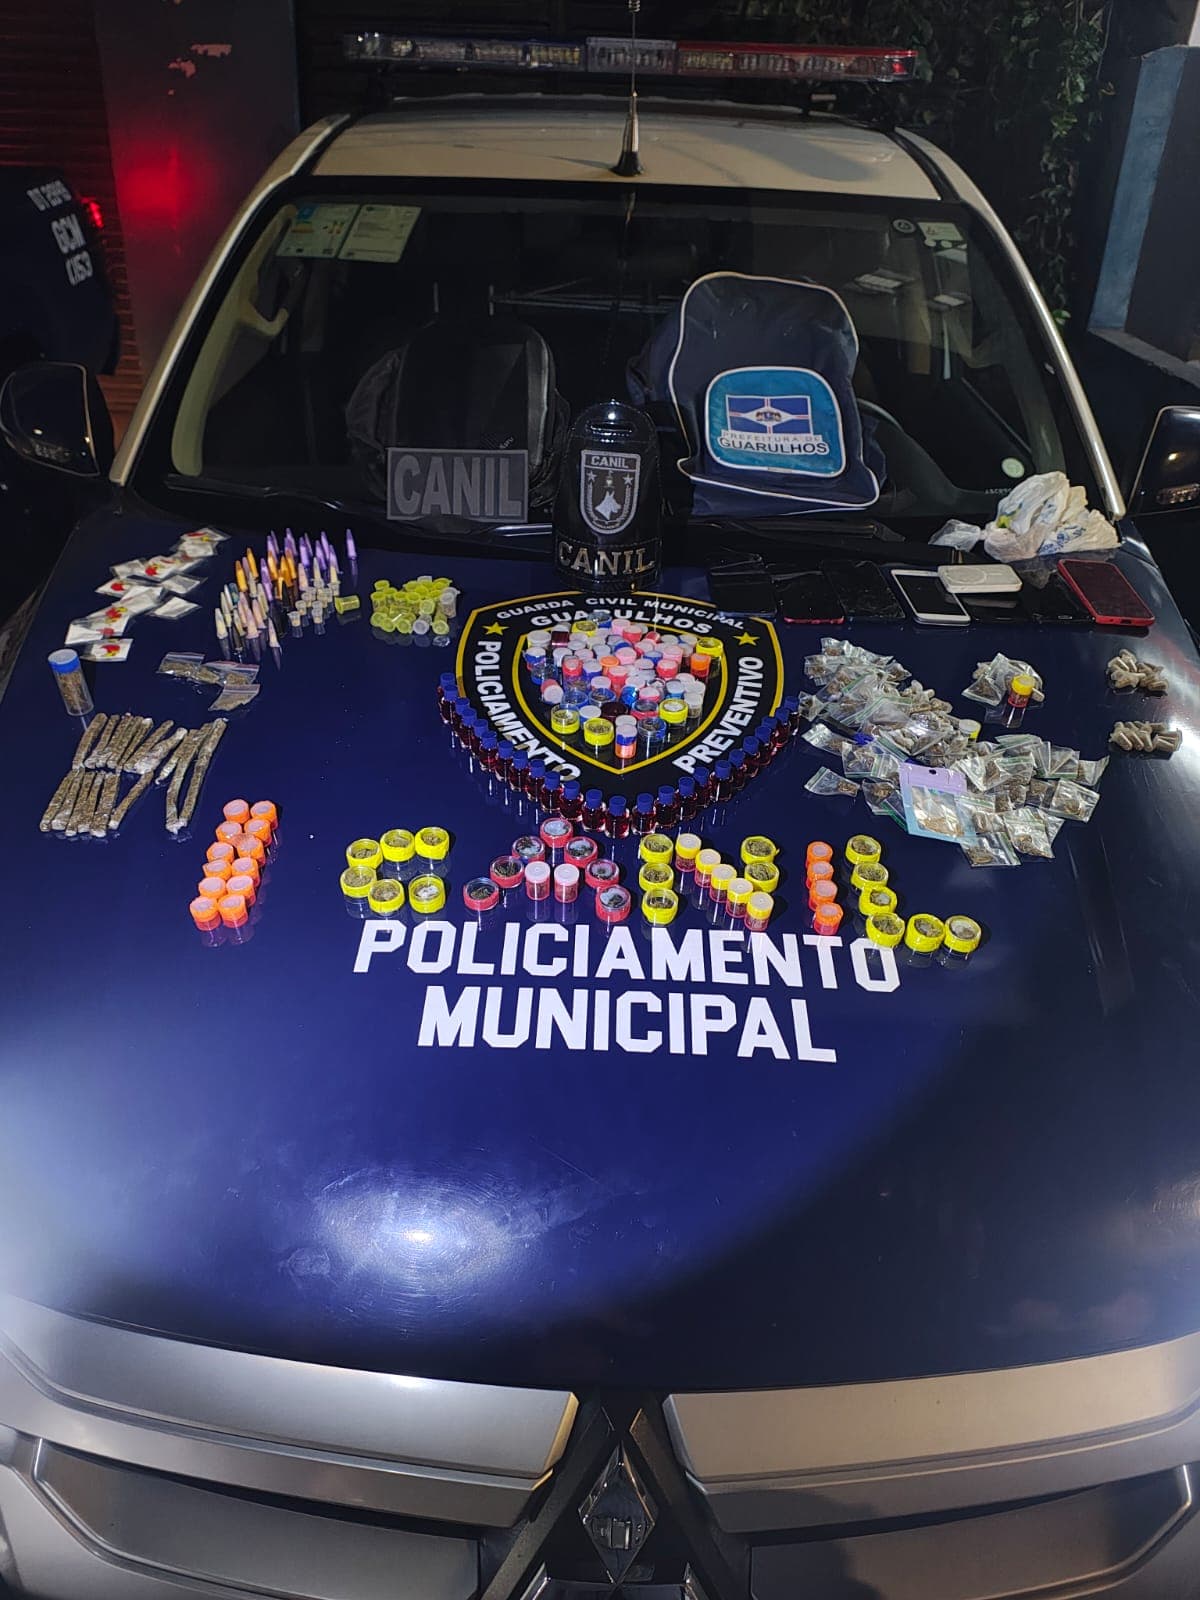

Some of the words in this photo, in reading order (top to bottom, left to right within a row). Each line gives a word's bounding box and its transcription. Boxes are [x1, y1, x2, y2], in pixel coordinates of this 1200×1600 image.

[719, 437, 828, 454] GUARULHOS
[722, 430, 798, 443] PREFEITURA
[393, 454, 523, 517] CANIL
[591, 455, 629, 469] CANIL
[559, 541, 656, 576] CANIL
[496, 599, 575, 620] GUARDA
[586, 597, 637, 606] CIVIL
[475, 641, 581, 782] POLICIAMENTO
[672, 656, 764, 774] PREVENTIVO
[354, 920, 900, 993] POLICIAMENTO
[418, 986, 837, 1063] MUNICIPAL
